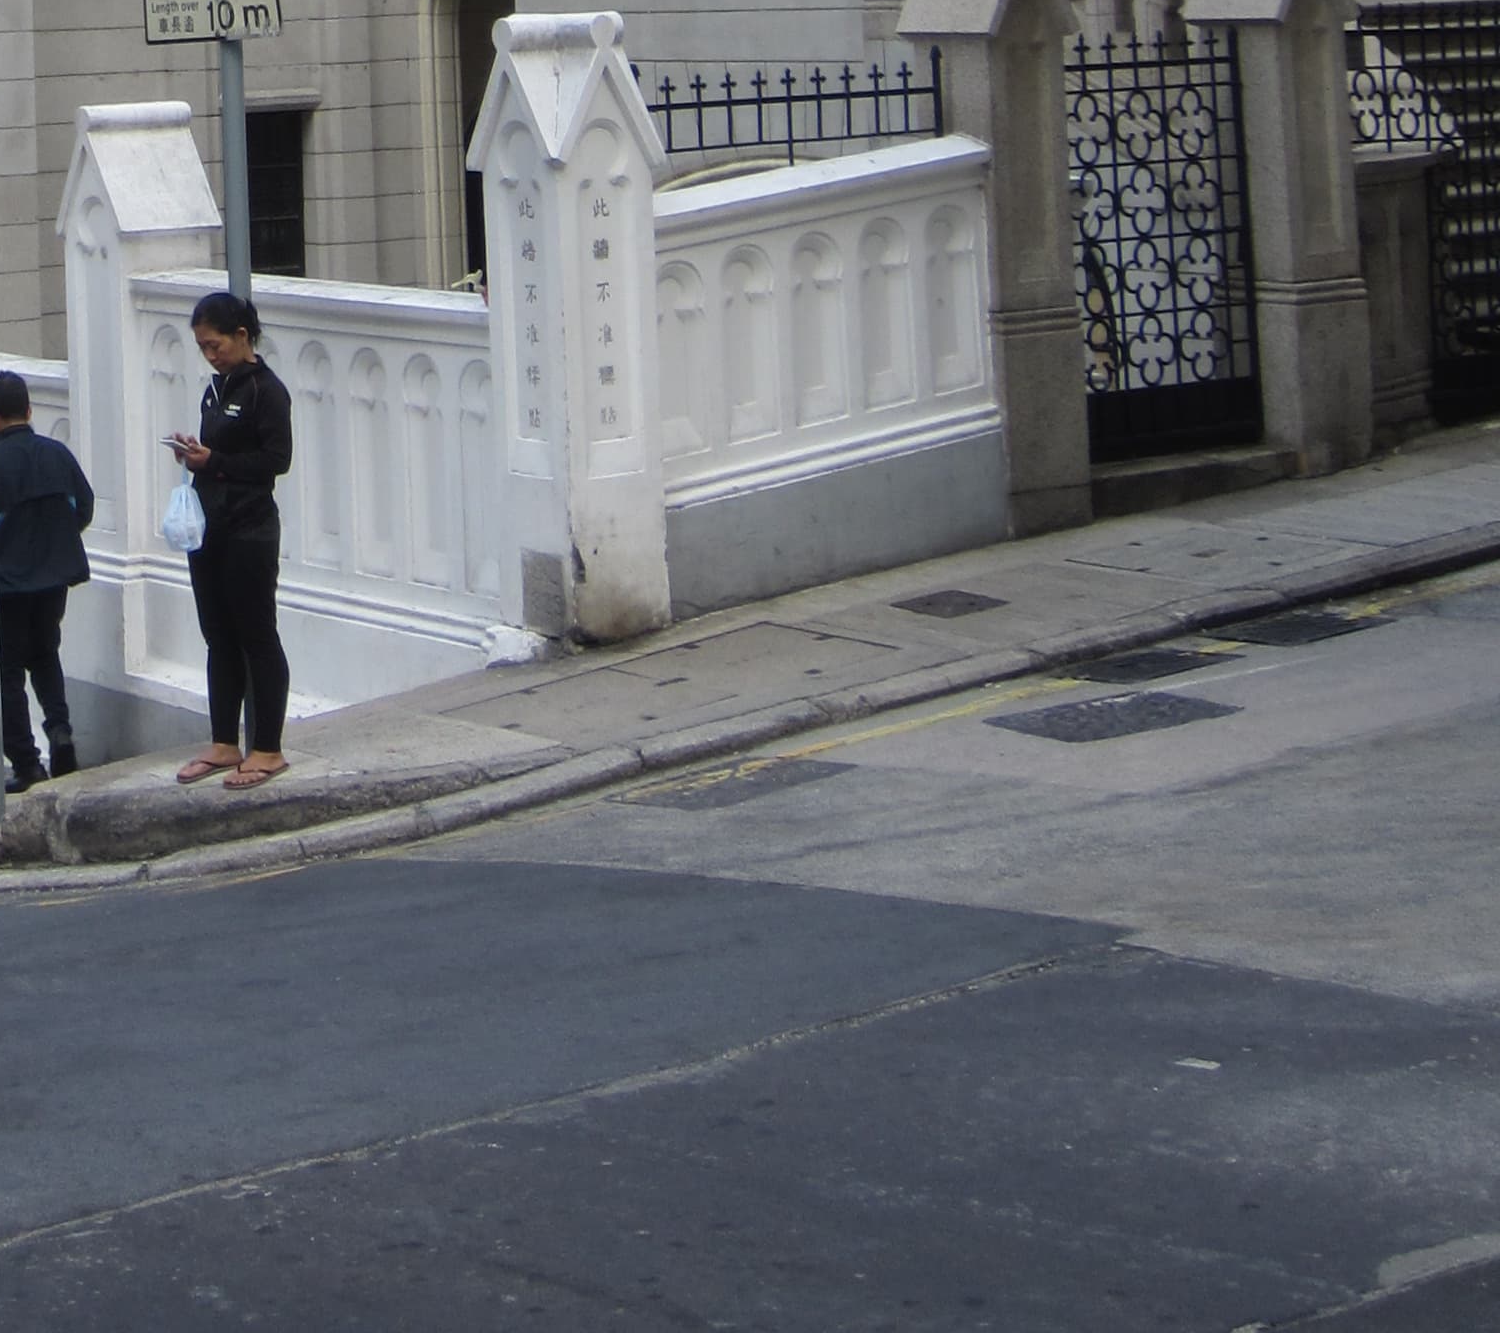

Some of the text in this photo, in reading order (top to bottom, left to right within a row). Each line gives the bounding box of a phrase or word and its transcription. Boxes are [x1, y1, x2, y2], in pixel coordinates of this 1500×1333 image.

[151, 0, 199, 15] Length over
[207, 0, 271, 32] 10 m
